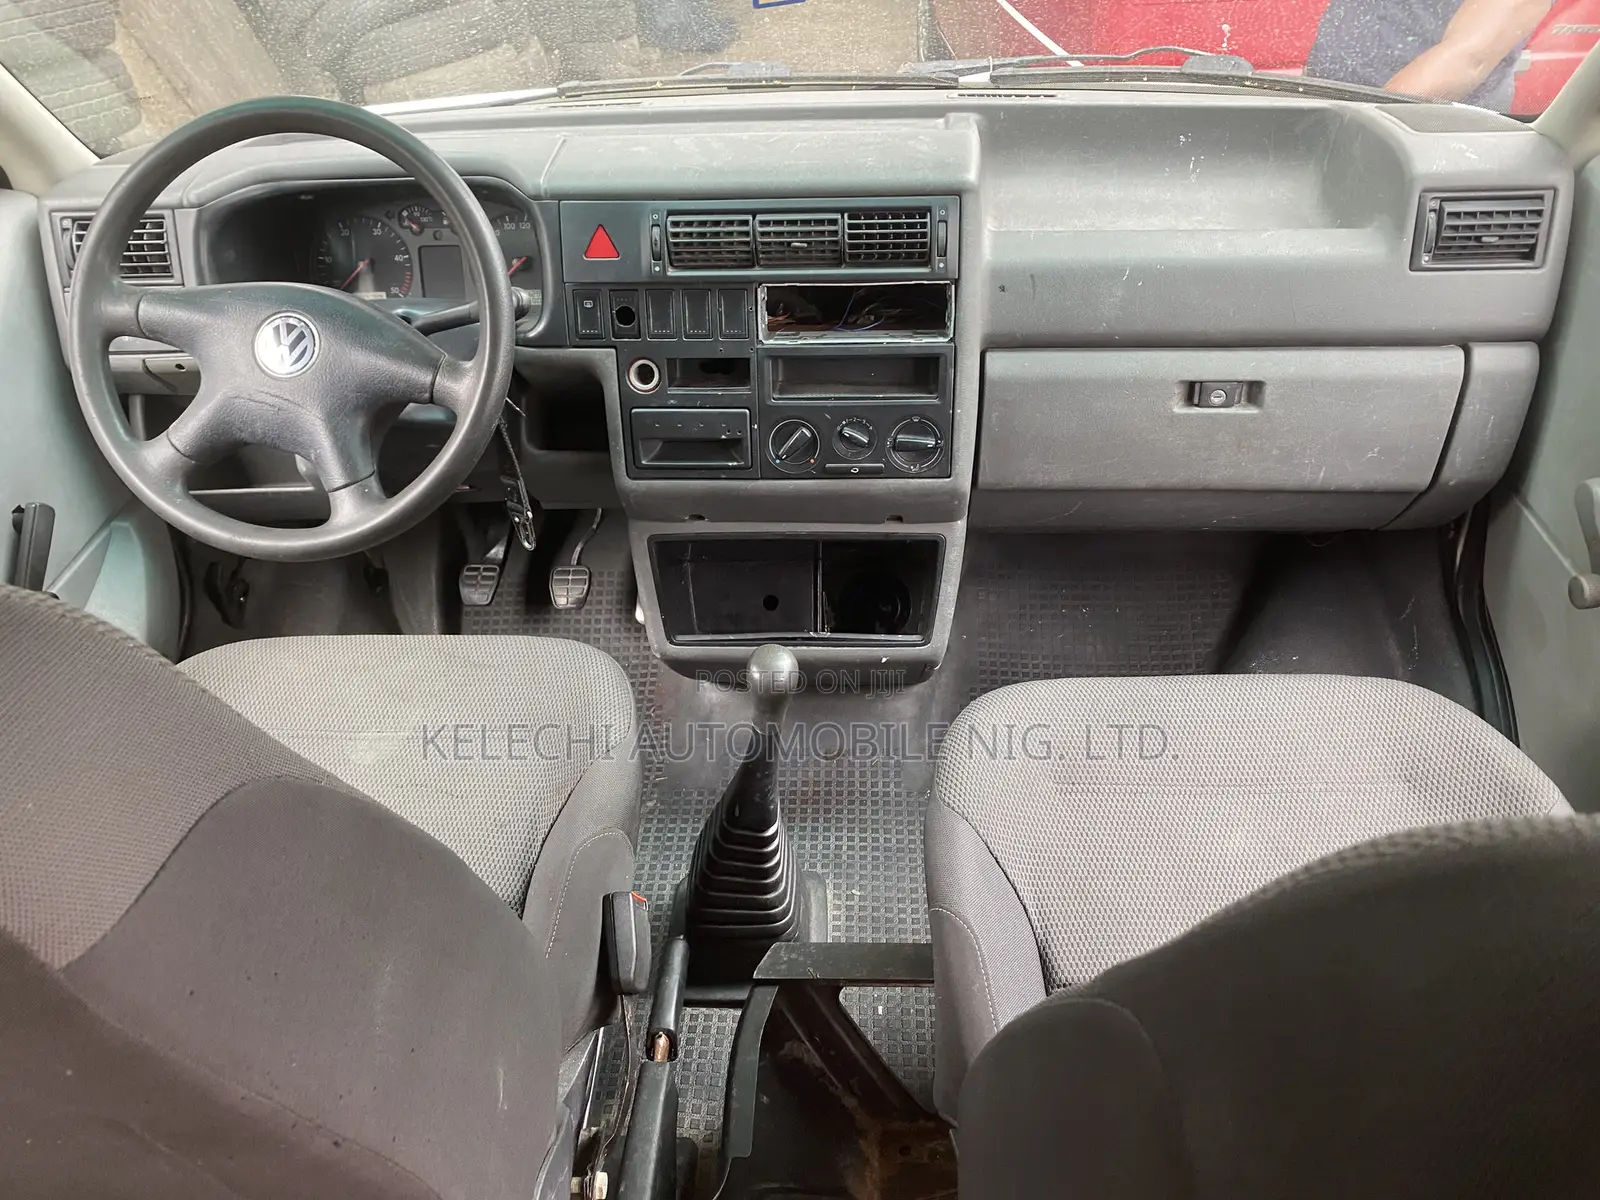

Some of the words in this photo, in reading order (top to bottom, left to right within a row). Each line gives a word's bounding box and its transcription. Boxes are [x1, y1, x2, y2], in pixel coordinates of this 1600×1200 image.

[503, 222, 516, 230] 100
[519, 222, 531, 230] 120
[372, 228, 382, 236] 30
[394, 254, 404, 262] 40
[390, 286, 400, 294] 50
